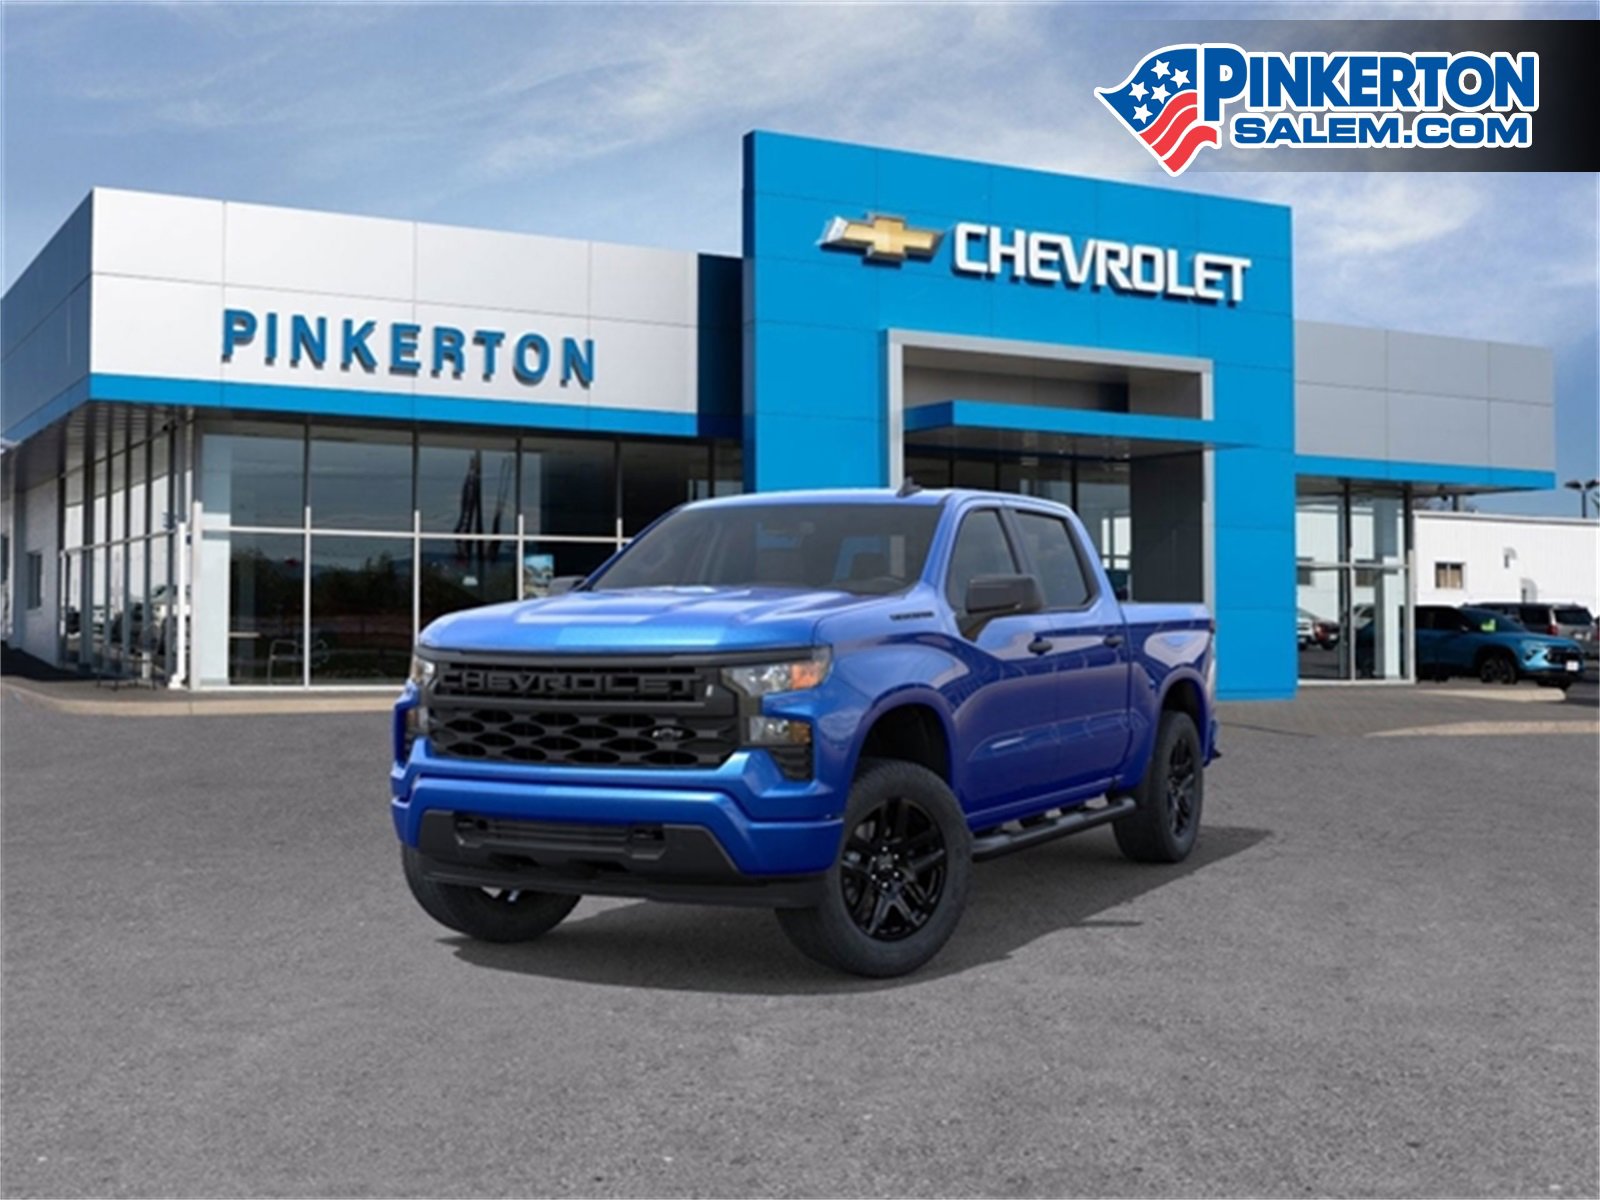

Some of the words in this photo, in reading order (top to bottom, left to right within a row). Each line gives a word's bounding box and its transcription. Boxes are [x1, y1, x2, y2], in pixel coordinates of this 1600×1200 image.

[953, 222, 1251, 302] CHEVROLET
[222, 308, 595, 386] PINKERTON
[438, 670, 702, 695] CHEVROLET
